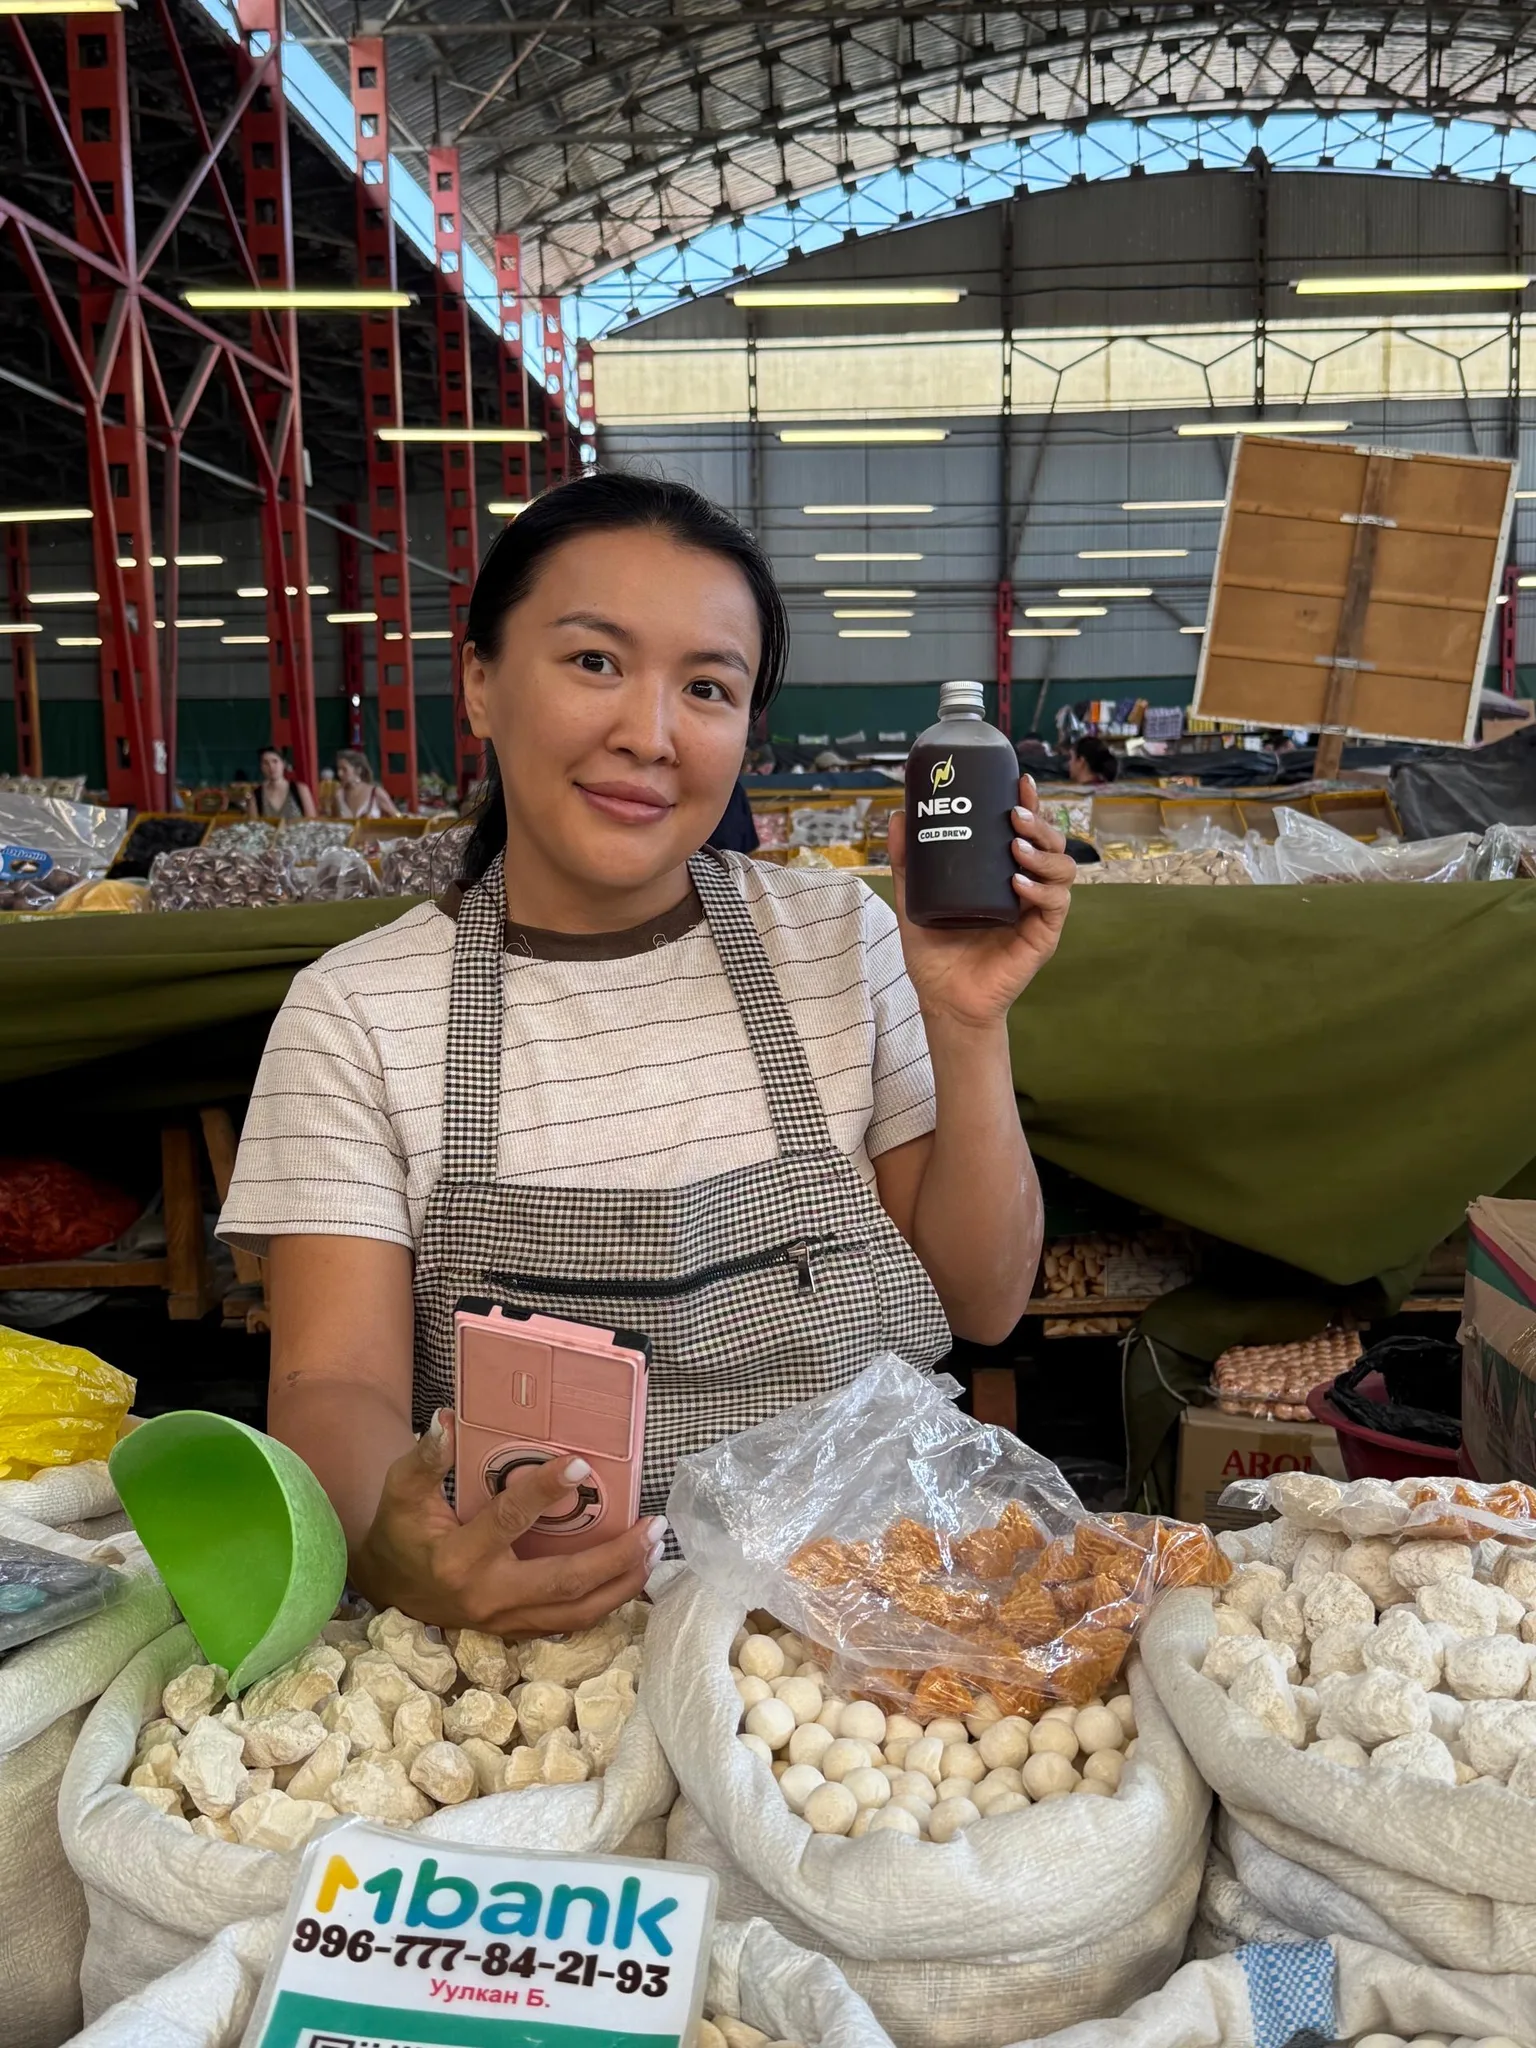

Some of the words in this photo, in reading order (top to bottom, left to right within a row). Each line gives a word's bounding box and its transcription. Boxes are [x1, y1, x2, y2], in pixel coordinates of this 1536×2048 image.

[917, 796, 973, 818] NEO
[920, 830, 941, 840] COLD
[942, 829, 968, 838] BREW
[292, 1917, 671, 1998] 996-777-84-21-93
[429, 1977, 519, 2006] Уулкан
[526, 1987, 551, 2009] Б.
